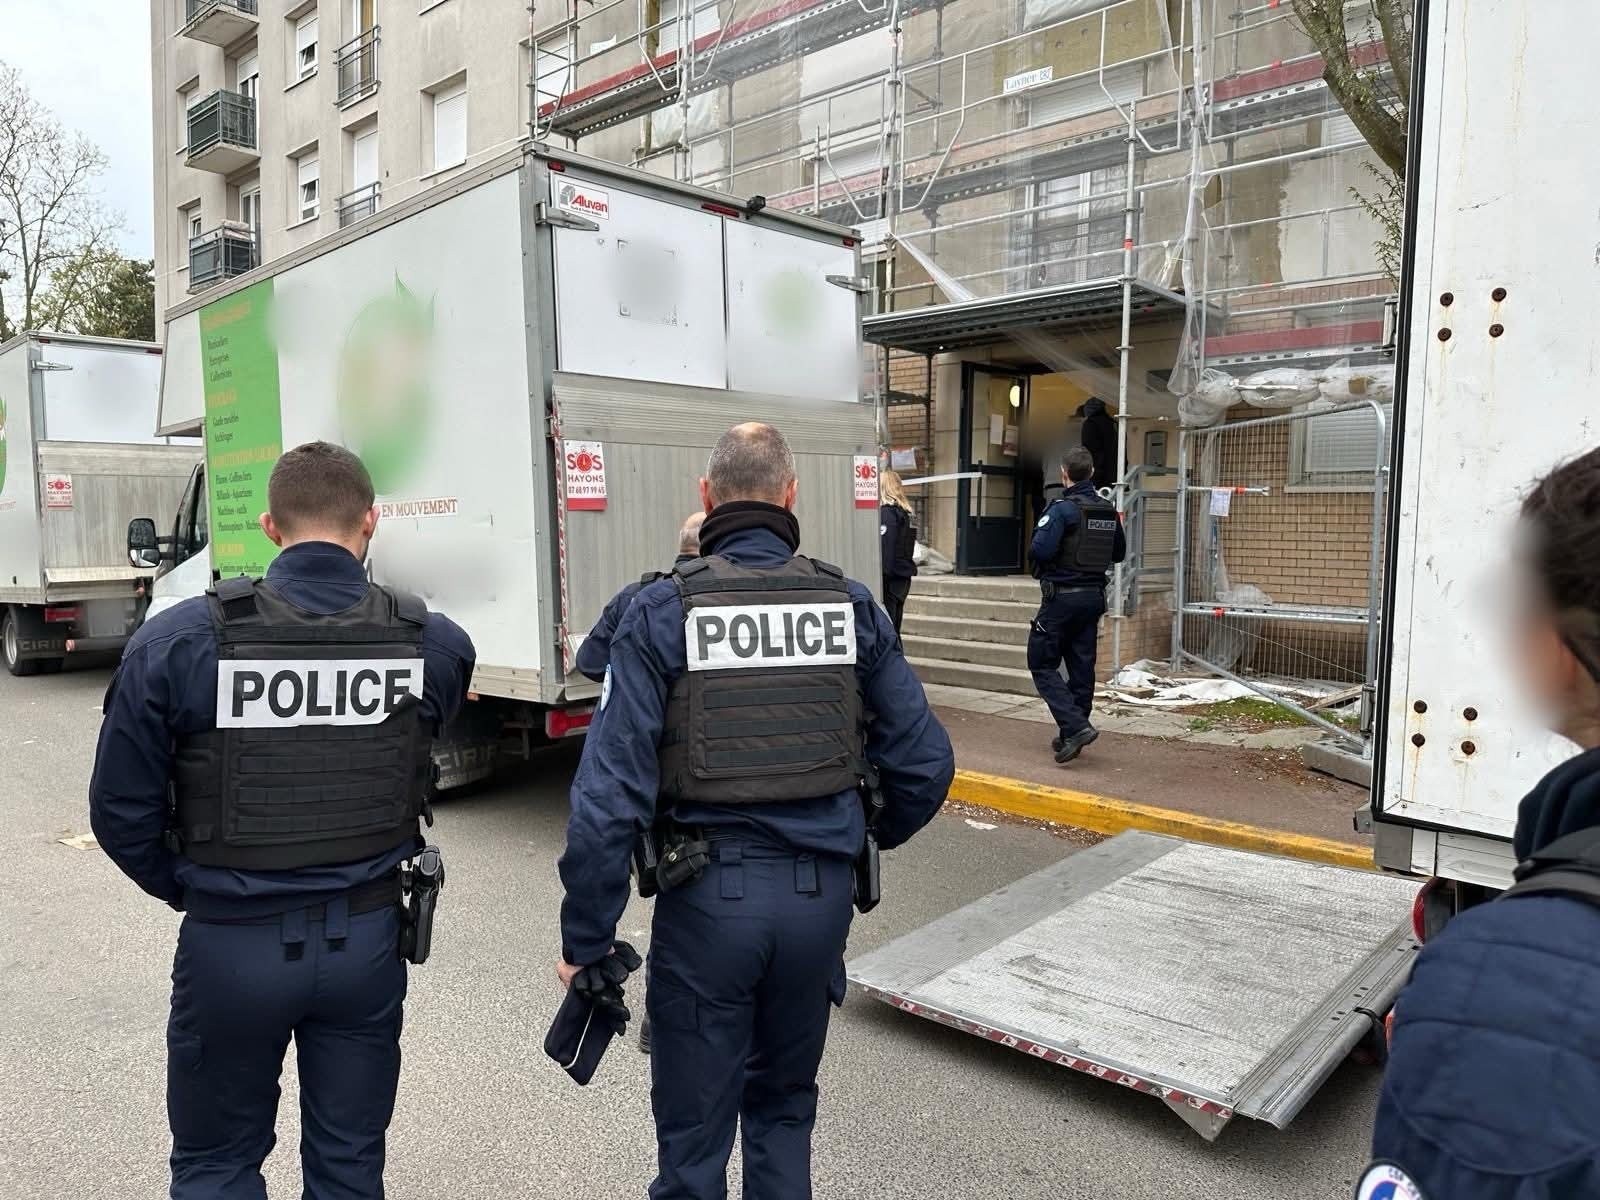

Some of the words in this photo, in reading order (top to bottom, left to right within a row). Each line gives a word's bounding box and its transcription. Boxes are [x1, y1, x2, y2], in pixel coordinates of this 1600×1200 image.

[571, 195, 608, 213] Aluvan
[567, 453, 603, 472] SOS
[568, 474, 604, 483] HAYONS
[855, 465, 877, 479] SOS
[48, 480, 72, 489] SOS
[382, 504, 394, 518] EN
[396, 499, 458, 517] MOUVEMENT
[1089, 521, 1115, 530] POLICE
[696, 611, 848, 661] POLICE
[231, 669, 411, 718] POLICE
